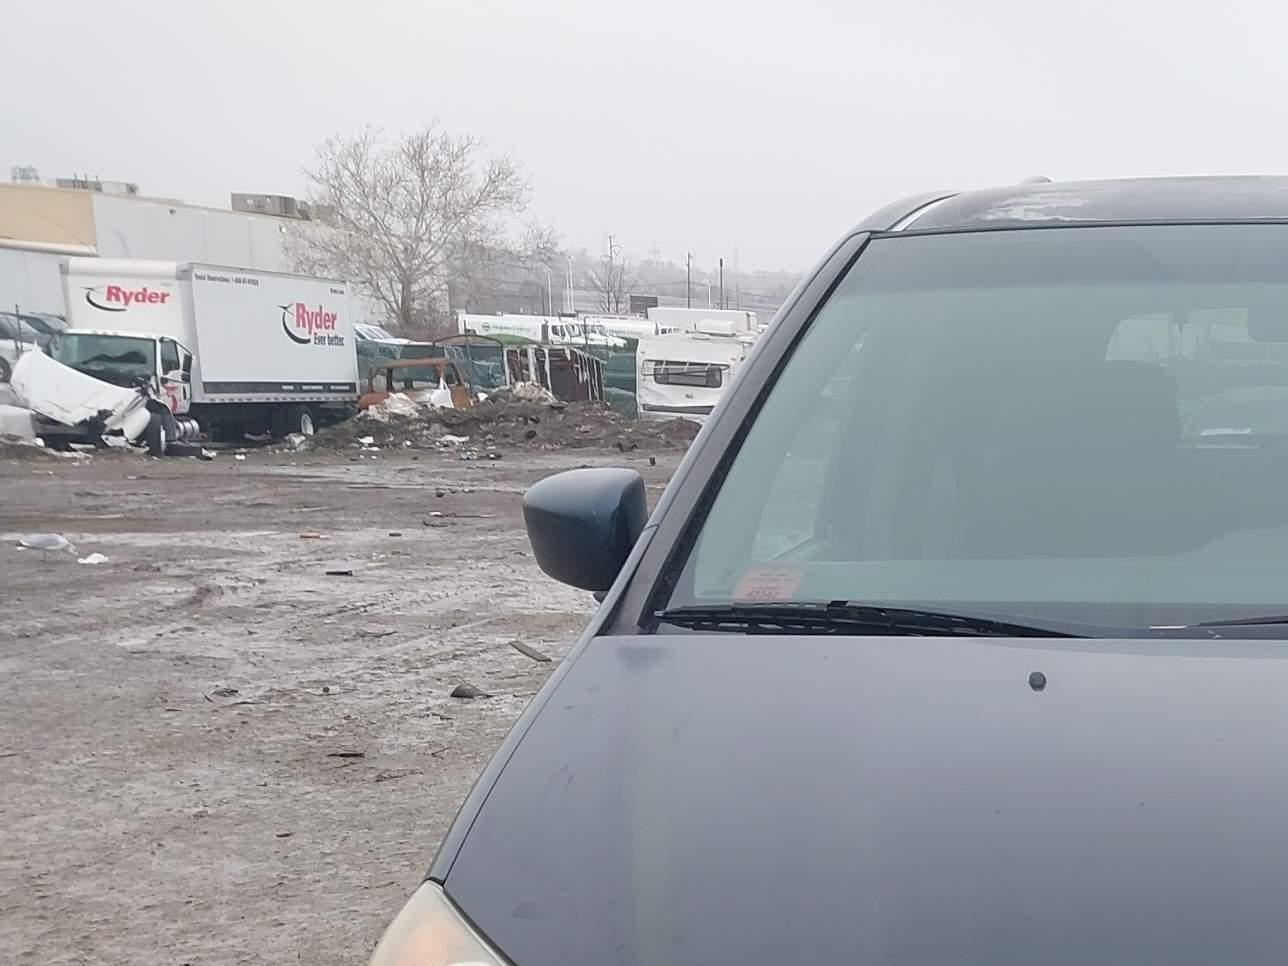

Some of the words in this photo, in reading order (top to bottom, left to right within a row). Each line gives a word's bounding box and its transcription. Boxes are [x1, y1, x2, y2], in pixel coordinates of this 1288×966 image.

[105, 285, 170, 306] Ryder
[295, 302, 337, 335] Ryder
[313, 332, 327, 346] Ever
